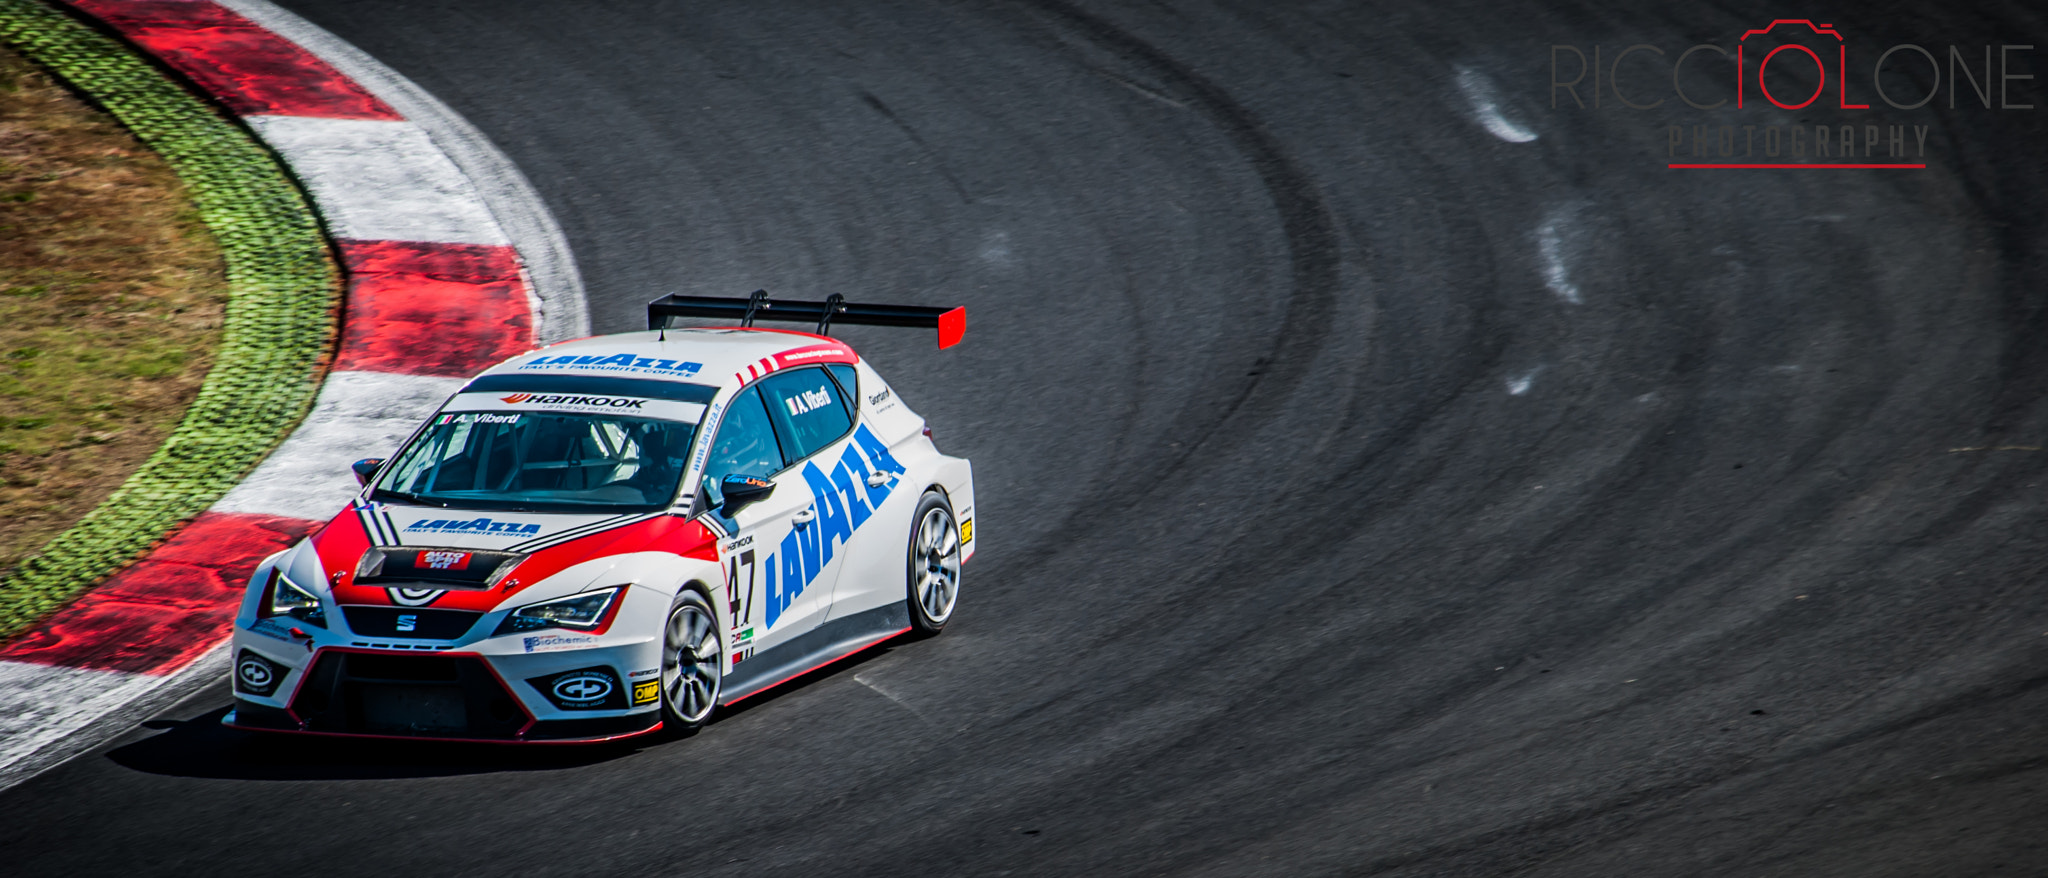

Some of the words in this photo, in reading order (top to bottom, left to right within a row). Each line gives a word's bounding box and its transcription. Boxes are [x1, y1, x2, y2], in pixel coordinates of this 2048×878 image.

[526, 354, 704, 374] LAVAZZA
[569, 365, 639, 373] FAVOURITE
[643, 369, 695, 378] COFFEE
[452, 414, 469, 423] A.
[474, 414, 521, 425] Viberti
[408, 518, 542, 534] LAVAZZA
[765, 423, 906, 630] LAVAZZA
[729, 549, 755, 628] 47
[634, 684, 659, 700] OMP
